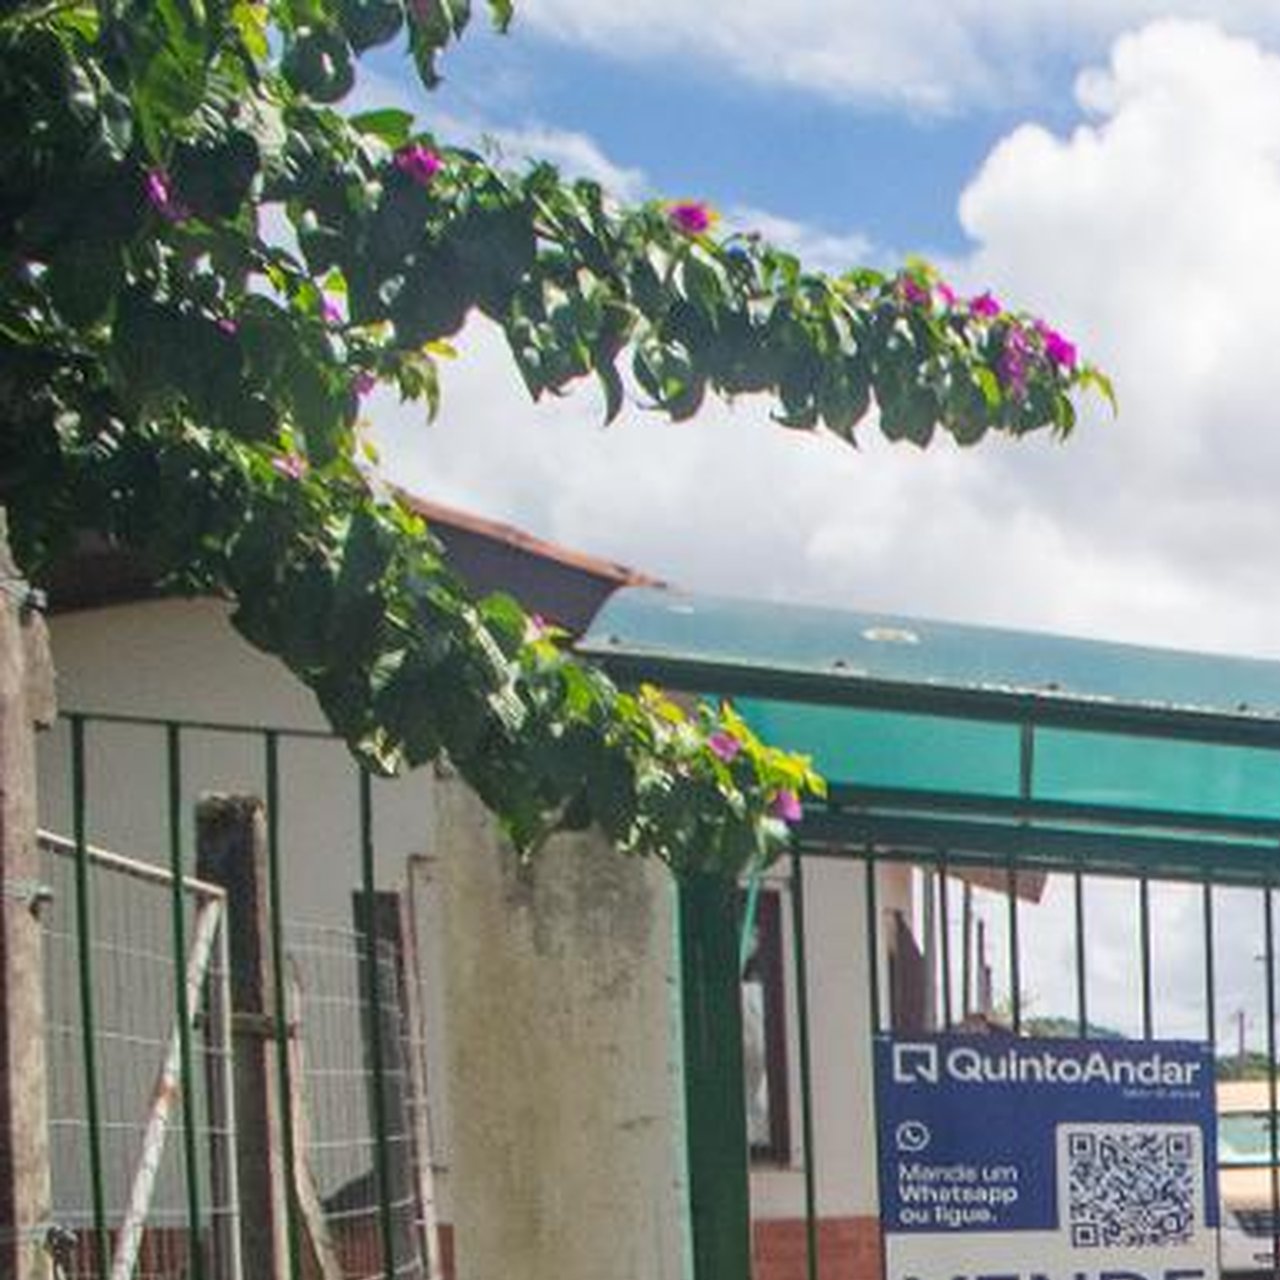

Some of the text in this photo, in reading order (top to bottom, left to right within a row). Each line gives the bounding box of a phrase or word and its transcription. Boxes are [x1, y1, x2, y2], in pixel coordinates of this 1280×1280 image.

[947, 1048, 1200, 1085] QuintoAndar
[982, 1164, 1018, 1182] um
[900, 1207, 929, 1223] ou
